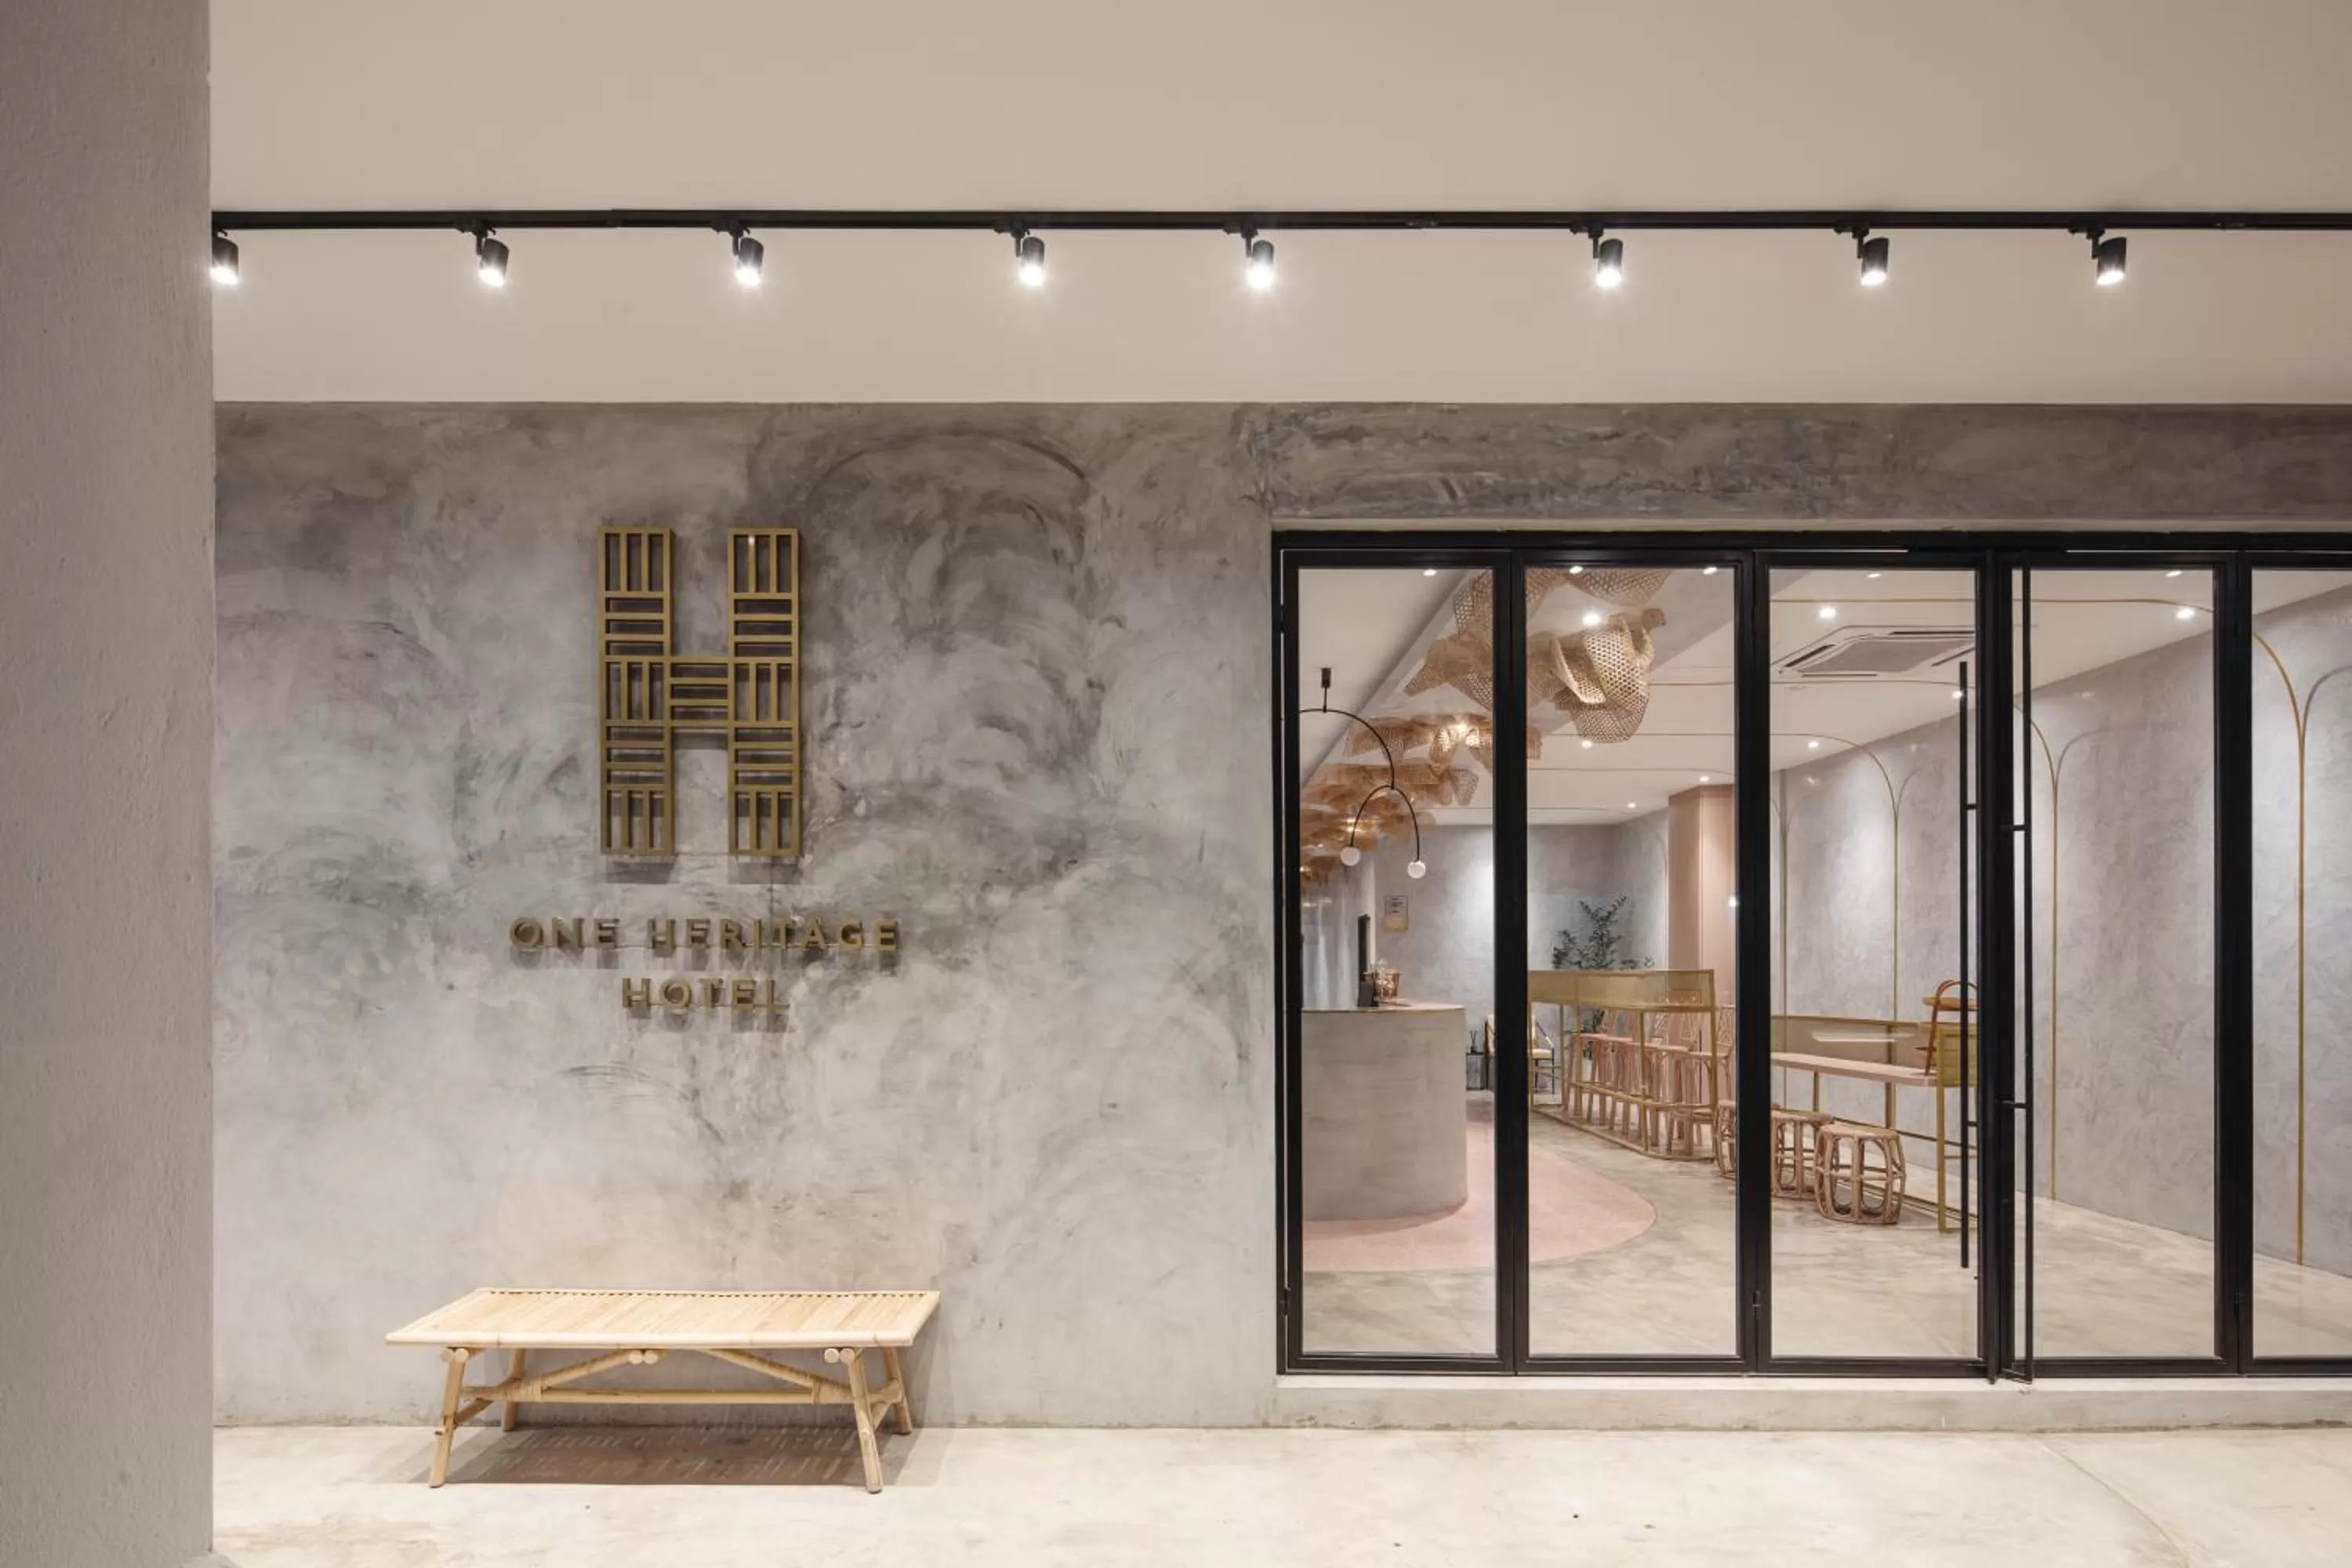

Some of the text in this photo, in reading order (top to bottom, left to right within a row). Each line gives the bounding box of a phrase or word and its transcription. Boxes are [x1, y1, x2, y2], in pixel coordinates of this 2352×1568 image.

[510, 916, 900, 952] ONE HERITAGE
[622, 977, 790, 1011] HOTEL
